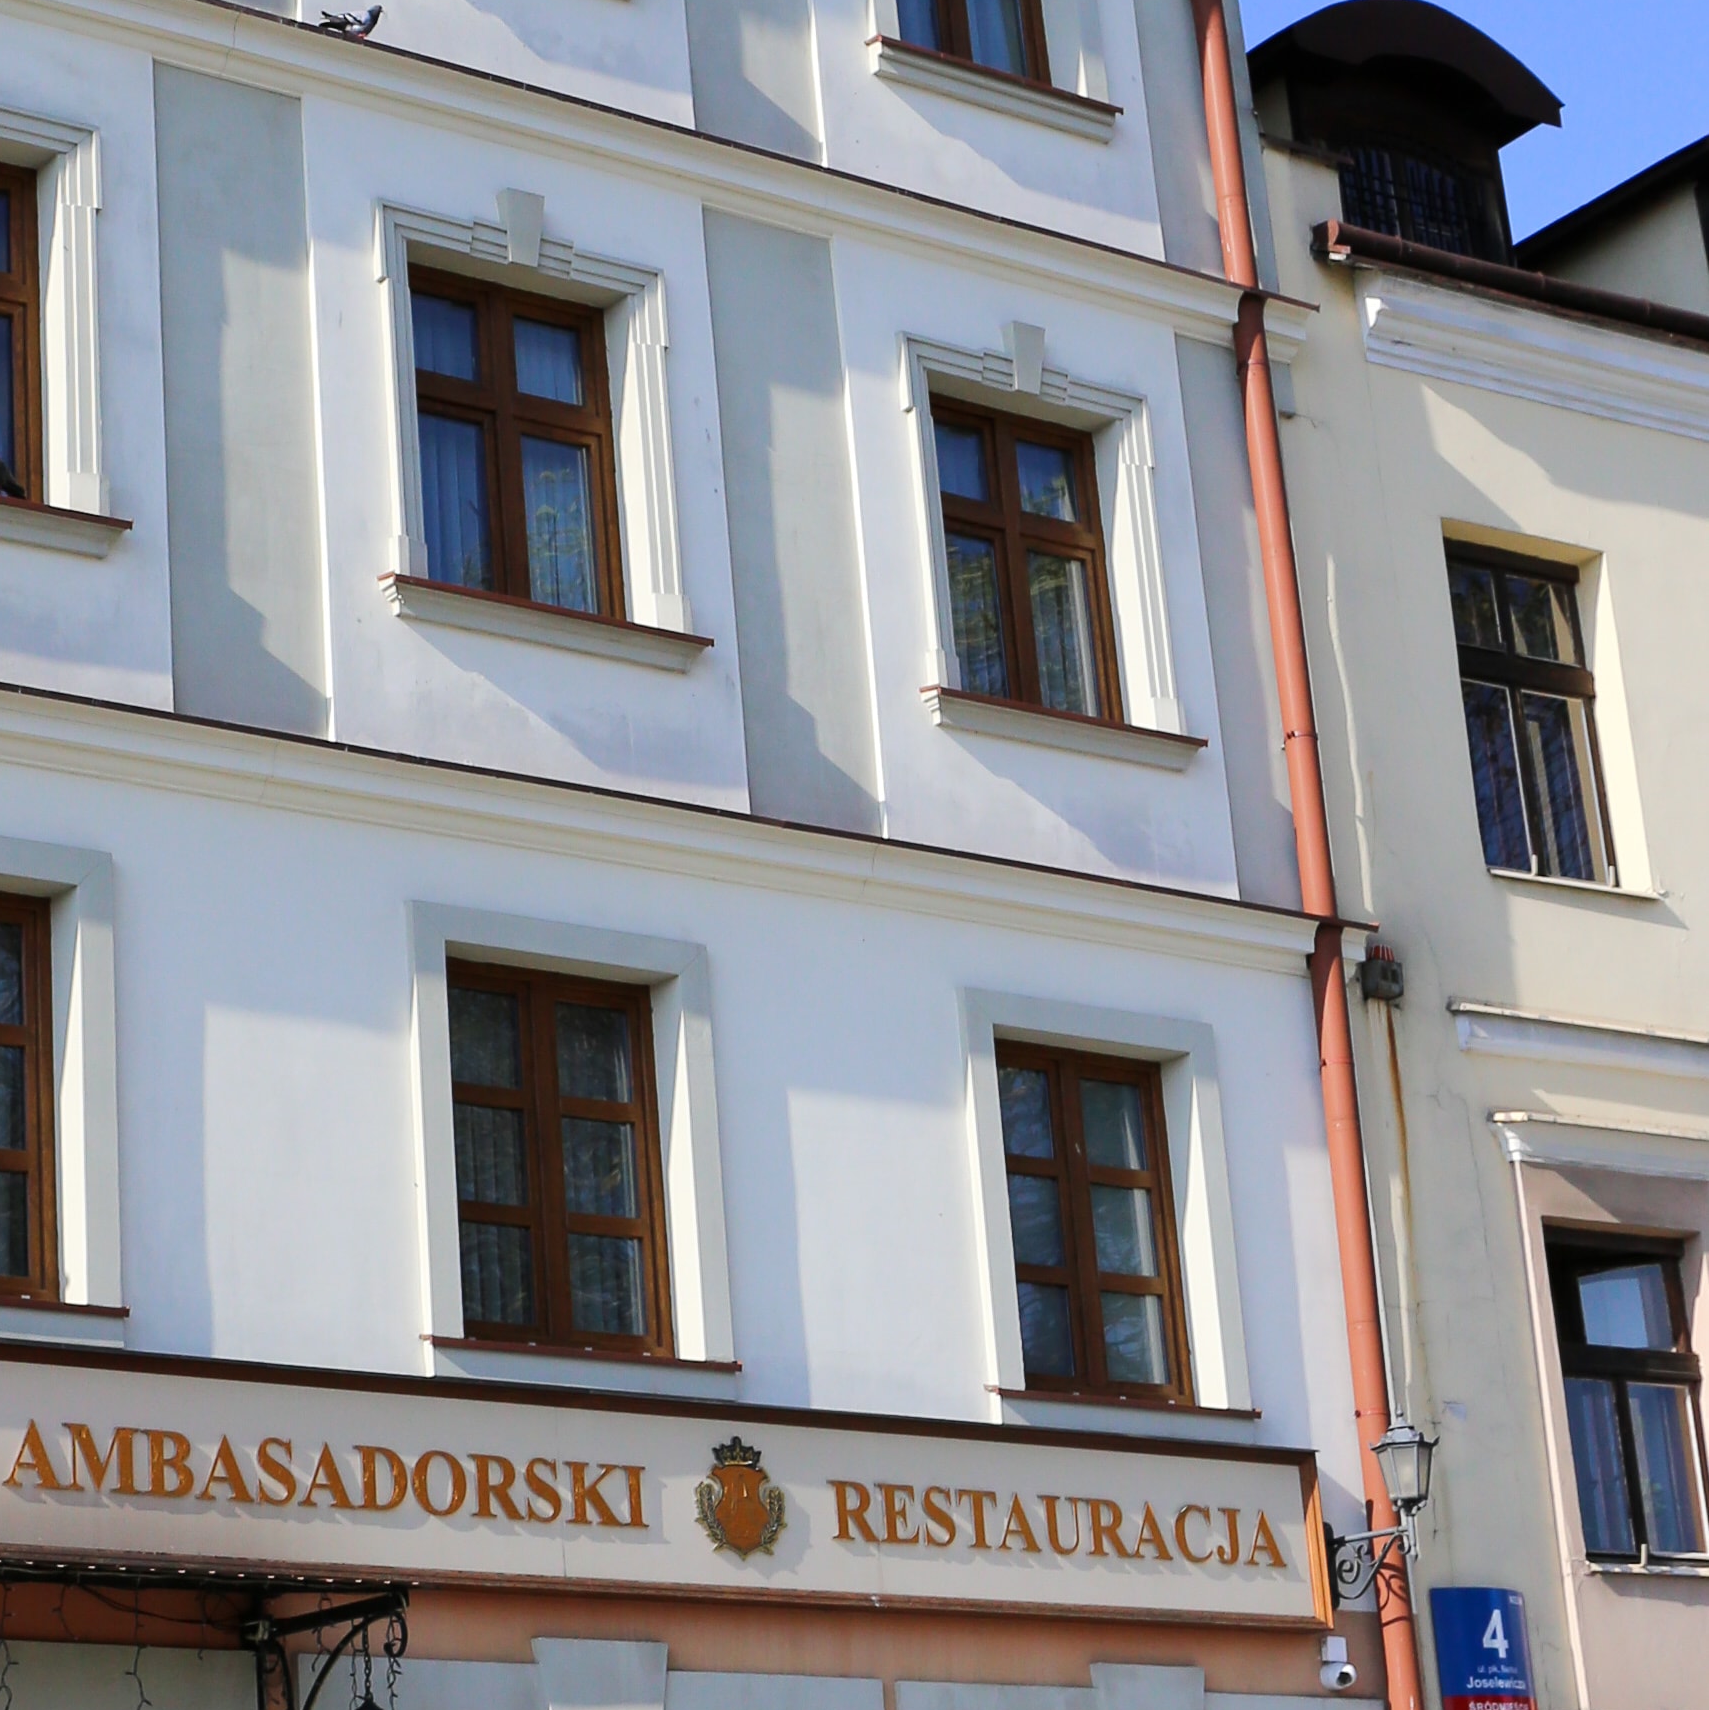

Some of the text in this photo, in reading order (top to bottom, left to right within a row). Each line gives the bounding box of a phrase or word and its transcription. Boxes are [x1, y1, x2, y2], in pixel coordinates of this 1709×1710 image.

[3, 1418, 650, 1527] AMBASADORSKI
[826, 1479, 1288, 1570] RESTAURACJA
[1483, 1609, 1509, 1658] 4
